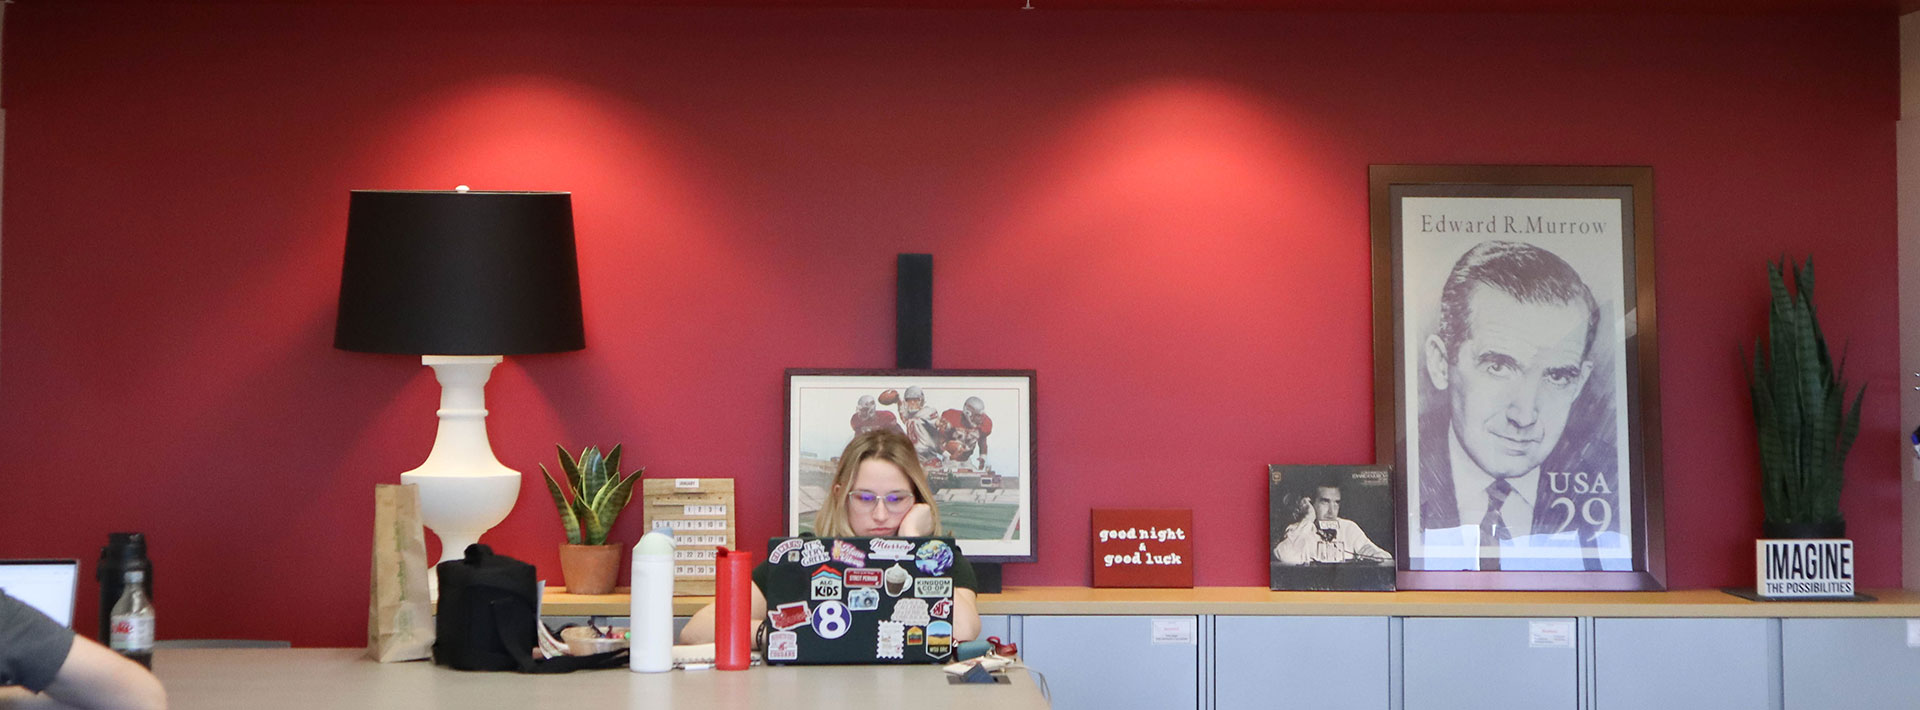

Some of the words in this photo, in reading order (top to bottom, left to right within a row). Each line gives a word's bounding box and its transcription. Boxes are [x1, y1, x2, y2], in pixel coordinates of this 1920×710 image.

[1421, 215, 1496, 233] Edward
[1547, 472, 1612, 493] USA
[1551, 497, 1612, 542] 29
[1099, 527, 1138, 543] good
[1139, 526, 1186, 543] night
[803, 547, 825, 557] VERY
[1138, 542, 1147, 552] &
[802, 554, 830, 565] GREEK
[1103, 551, 1143, 568] good
[1145, 552, 1183, 566] luck
[1765, 543, 1852, 580] IMAGINE
[1766, 583, 1785, 593] THE
[1786, 582, 1852, 593] POSSIBILITIES
[819, 600, 847, 639] 8
